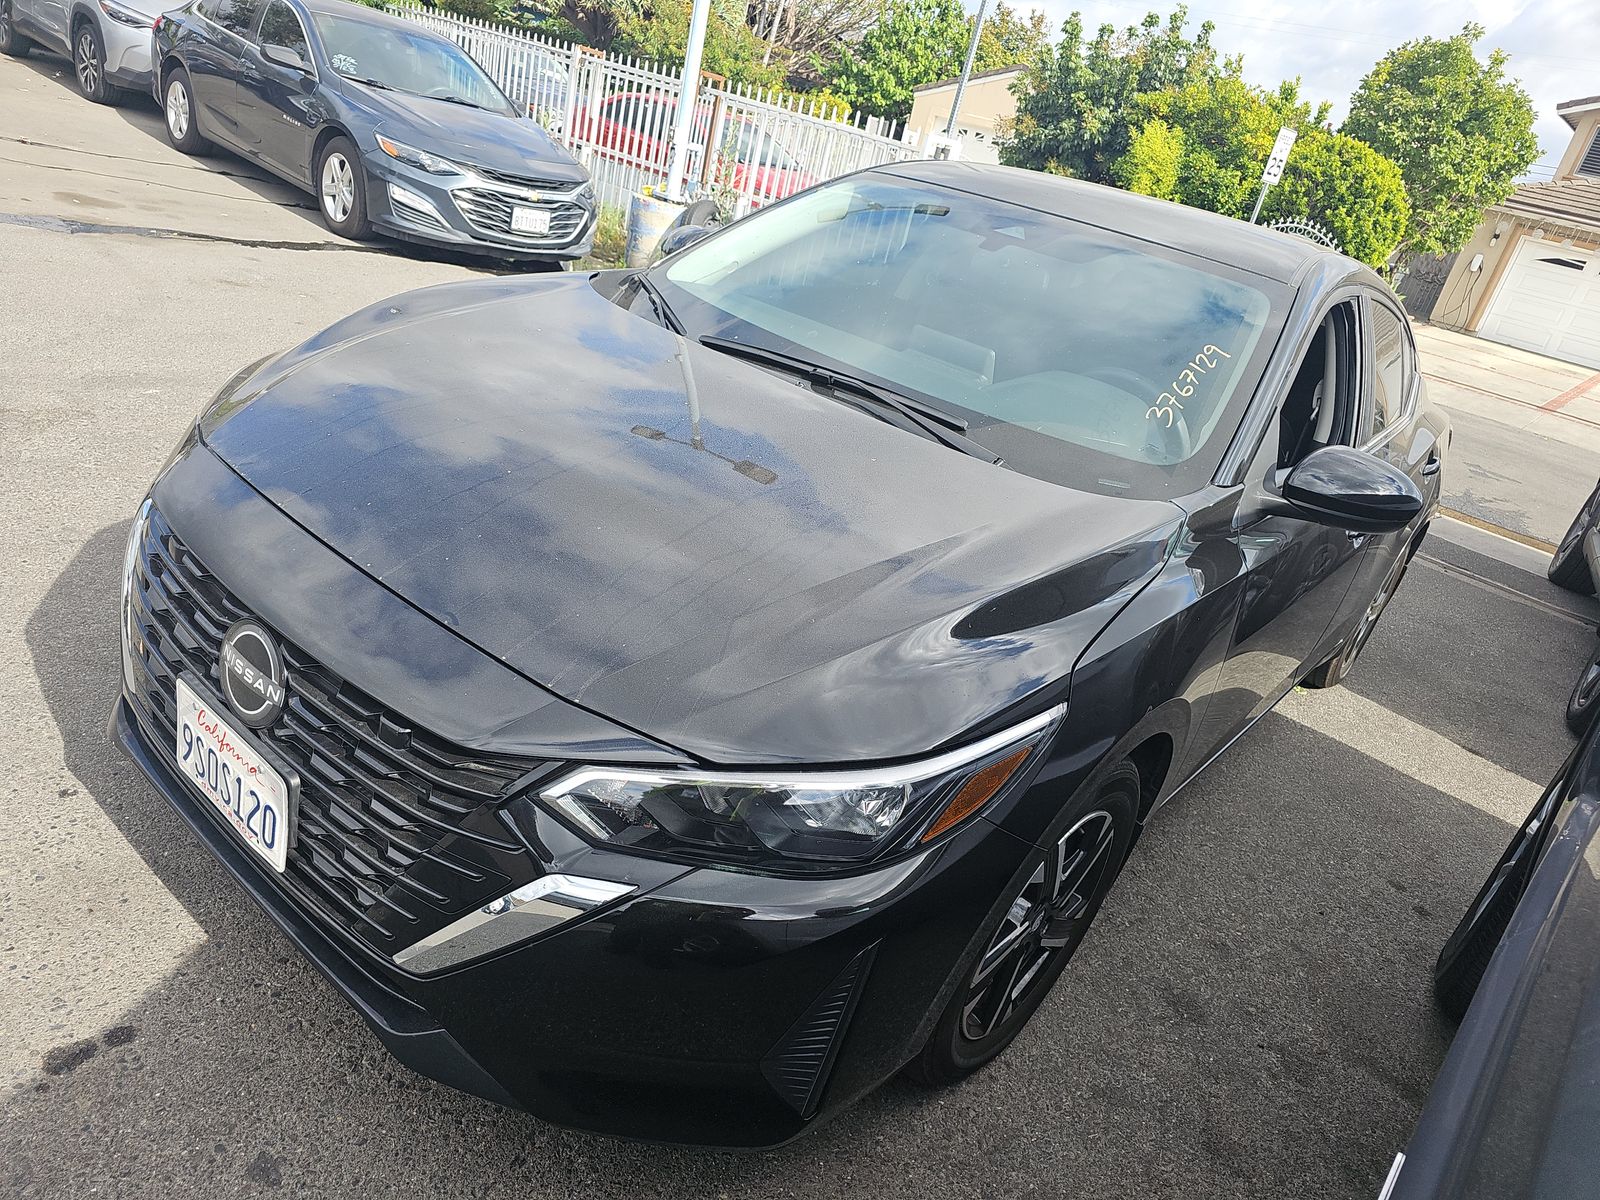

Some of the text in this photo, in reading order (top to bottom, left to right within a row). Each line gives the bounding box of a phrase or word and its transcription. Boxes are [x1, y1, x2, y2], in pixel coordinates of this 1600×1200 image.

[1266, 157, 1284, 178] 25
[1145, 344, 1232, 428] 3767129
[223, 641, 280, 702] NISSAN
[183, 723, 277, 850] 9SDS120
[197, 709, 265, 789] California
